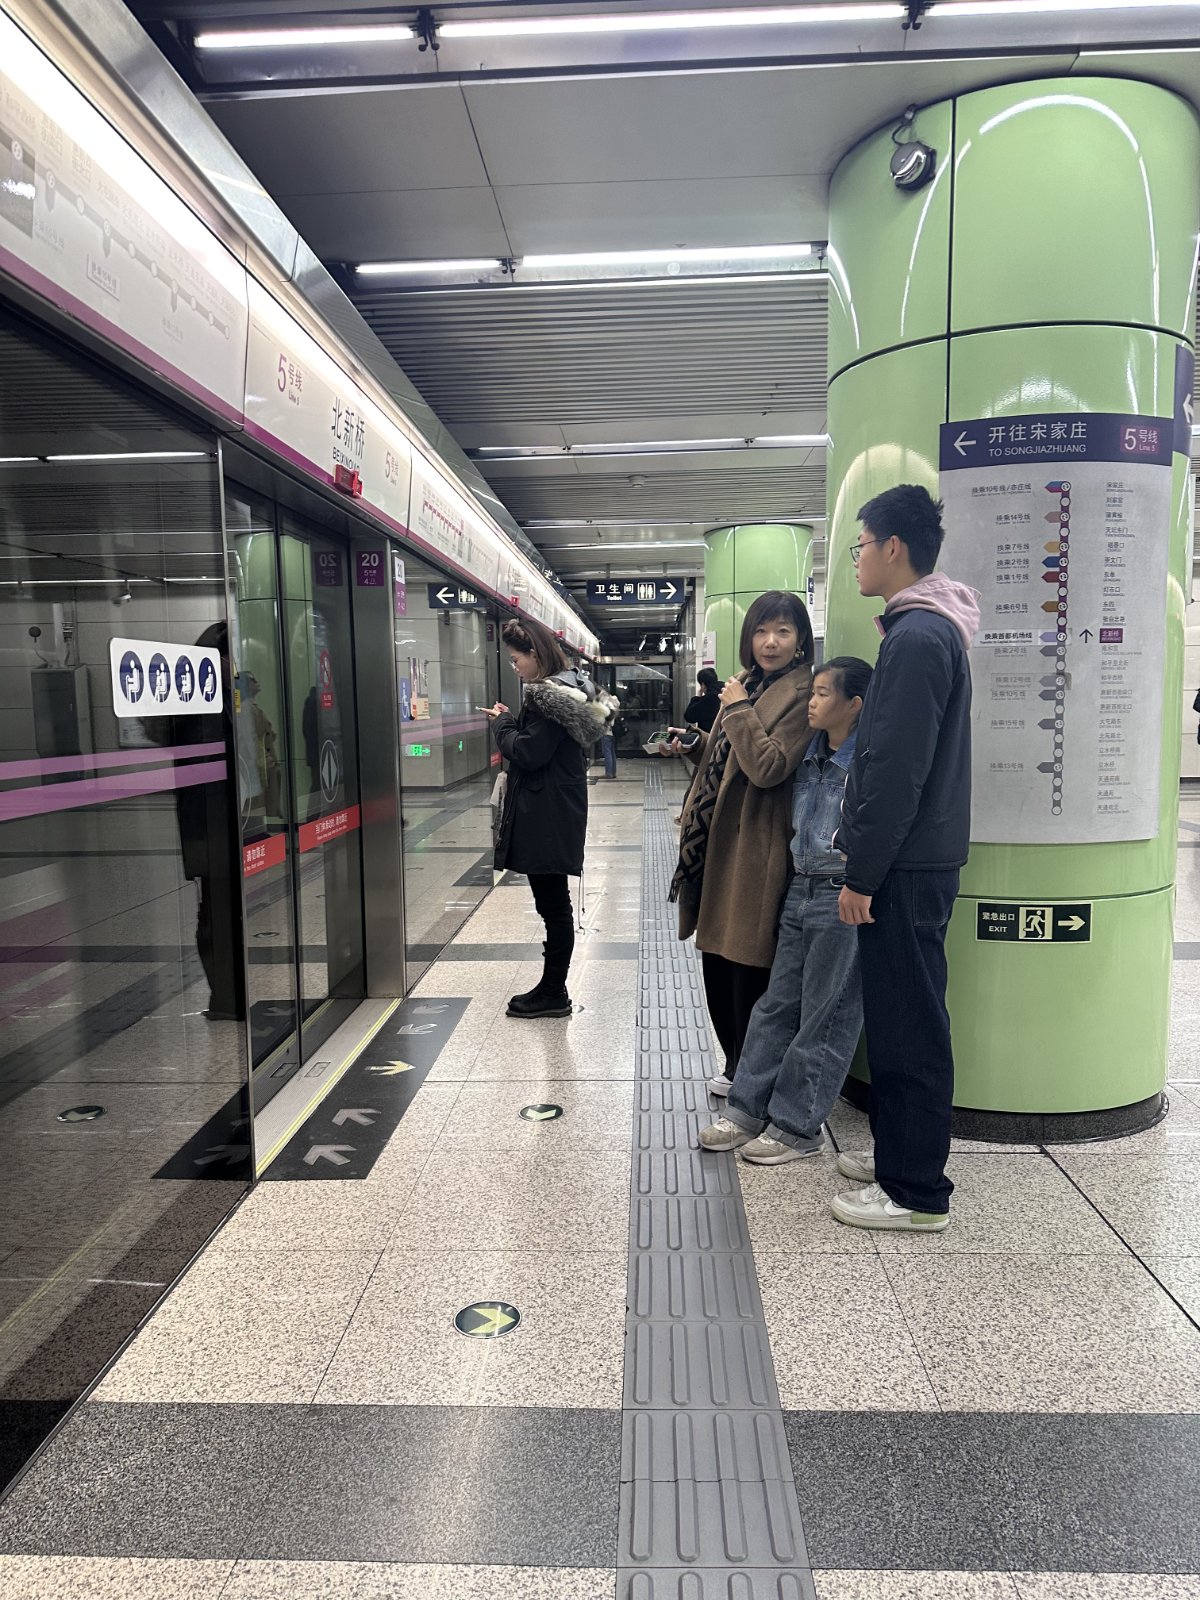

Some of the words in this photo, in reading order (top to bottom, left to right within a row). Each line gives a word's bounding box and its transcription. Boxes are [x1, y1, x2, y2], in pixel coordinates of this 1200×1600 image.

[278, 353, 302, 392] 5号线
[331, 396, 365, 459] 北新桥
[988, 421, 1087, 444] 开往宋家庄
[1124, 428, 1158, 450] 5号线
[989, 448, 1002, 457] TO
[1004, 444, 1086, 456] SONGJIAZHUANG
[361, 553, 380, 567] 20
[595, 583, 634, 594] 卫生间
[982, 911, 1015, 921] 紧急出口
[988, 925, 1008, 933] EXIT
